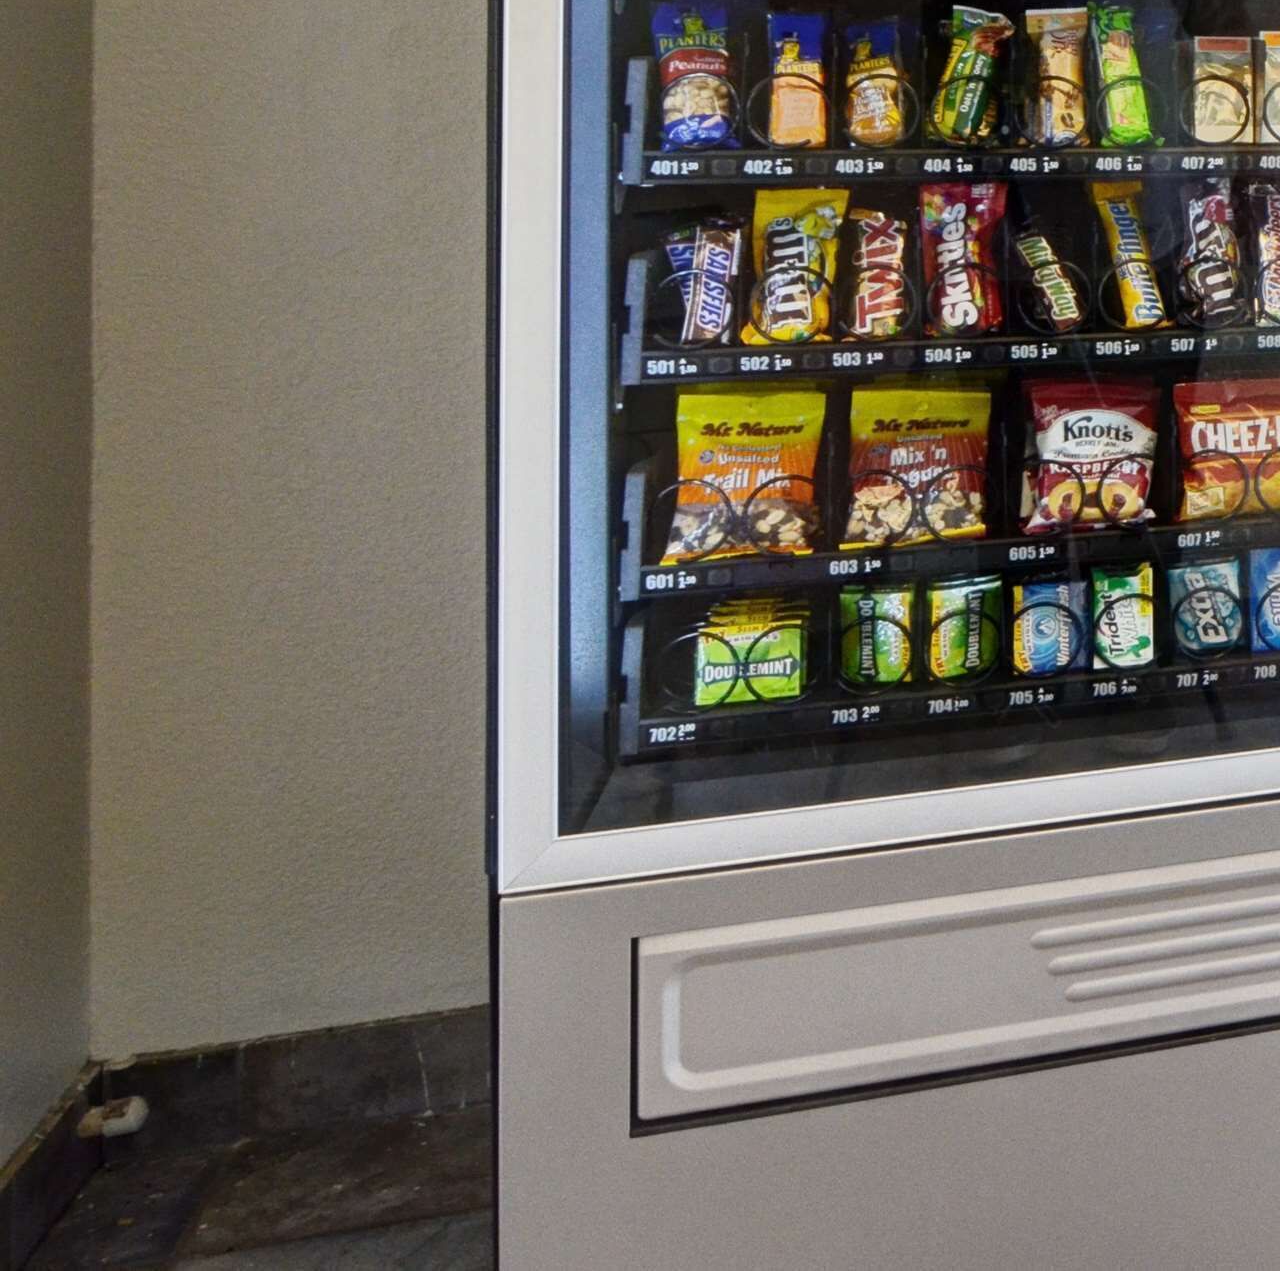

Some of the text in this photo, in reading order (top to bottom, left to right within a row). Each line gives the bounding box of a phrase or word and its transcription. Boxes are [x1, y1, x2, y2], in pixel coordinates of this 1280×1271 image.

[660, 34, 726, 52] PLANTERS
[669, 59, 727, 72] Peanuts
[651, 159, 678, 175] 401
[744, 159, 771, 174] 402
[836, 159, 863, 174] 403
[924, 159, 950, 172] 404
[1010, 158, 1036, 171] 405
[1096, 157, 1122, 171] 406
[1182, 156, 1204, 169] 407
[1011, 345, 1038, 358] 505
[1096, 341, 1122, 355] 506
[1171, 338, 1195, 351] 507
[833, 353, 861, 366] 503
[925, 349, 952, 363] 504
[648, 359, 675, 374] 501
[741, 356, 769, 371] 502
[736, 422, 806, 436] Nature
[907, 419, 970, 432] Nature
[1063, 416, 1134, 443] Knott's
[718, 453, 779, 464] Unsalted
[891, 447, 924, 466] Mix
[1178, 534, 1201, 547] 607
[1010, 546, 1036, 560] 605
[830, 560, 857, 574] 603
[646, 575, 674, 590] 601
[1184, 572, 1228, 644] Extra
[1103, 593, 1124, 656] Trident
[1255, 666, 1276, 678] 708
[1177, 674, 1197, 687] 707
[1093, 684, 1116, 697] 706
[1010, 692, 1033, 706] 705
[928, 700, 952, 714] 704
[832, 708, 857, 724] 703
[650, 726, 677, 742] 702
